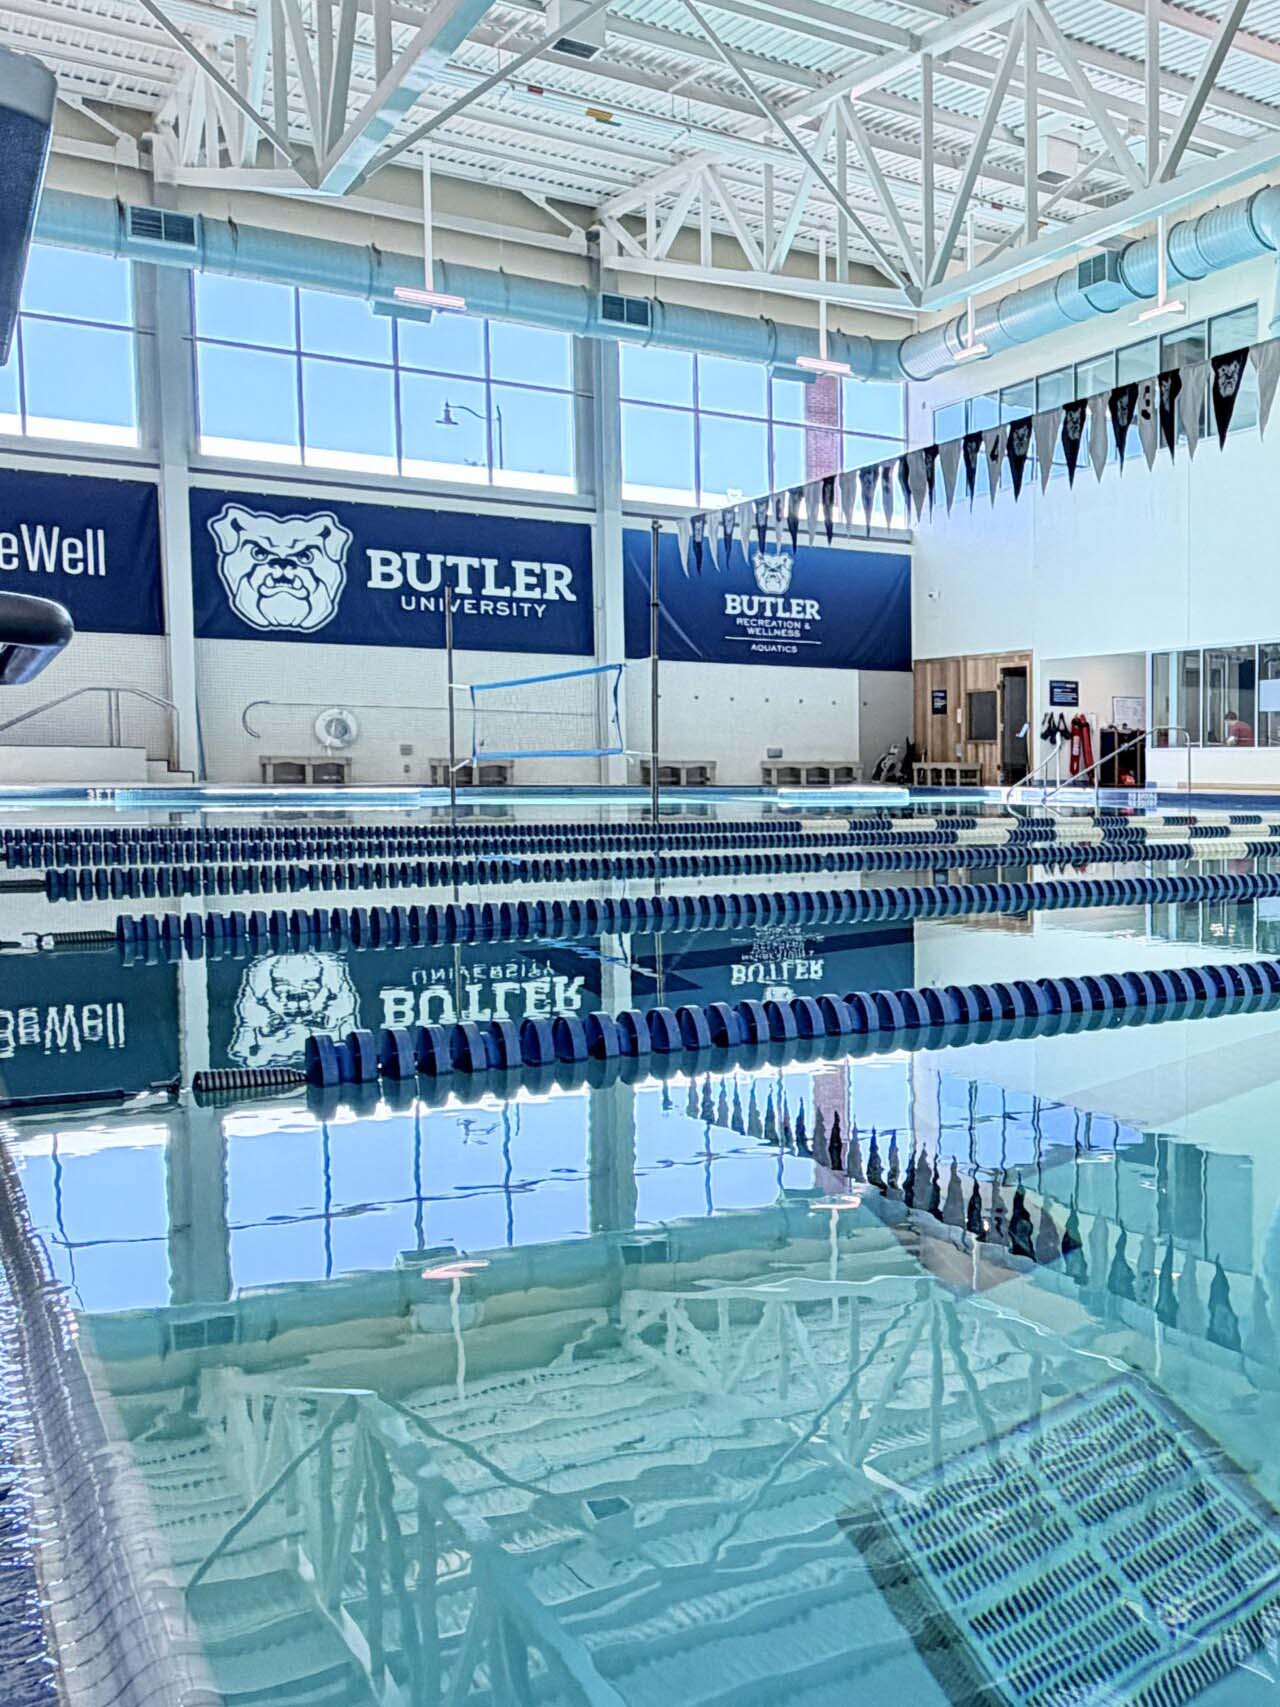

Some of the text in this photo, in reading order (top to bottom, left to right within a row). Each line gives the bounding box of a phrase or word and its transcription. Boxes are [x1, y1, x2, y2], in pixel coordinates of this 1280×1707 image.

[366, 549, 577, 601] BUTLER
[401, 595, 547, 618] UNIVERSITY
[724, 593, 821, 620] BUTLER
[736, 617, 811, 630] RECREATION &
[746, 627, 801, 638] WELLNESS
[751, 643, 798, 654] AQUATICS
